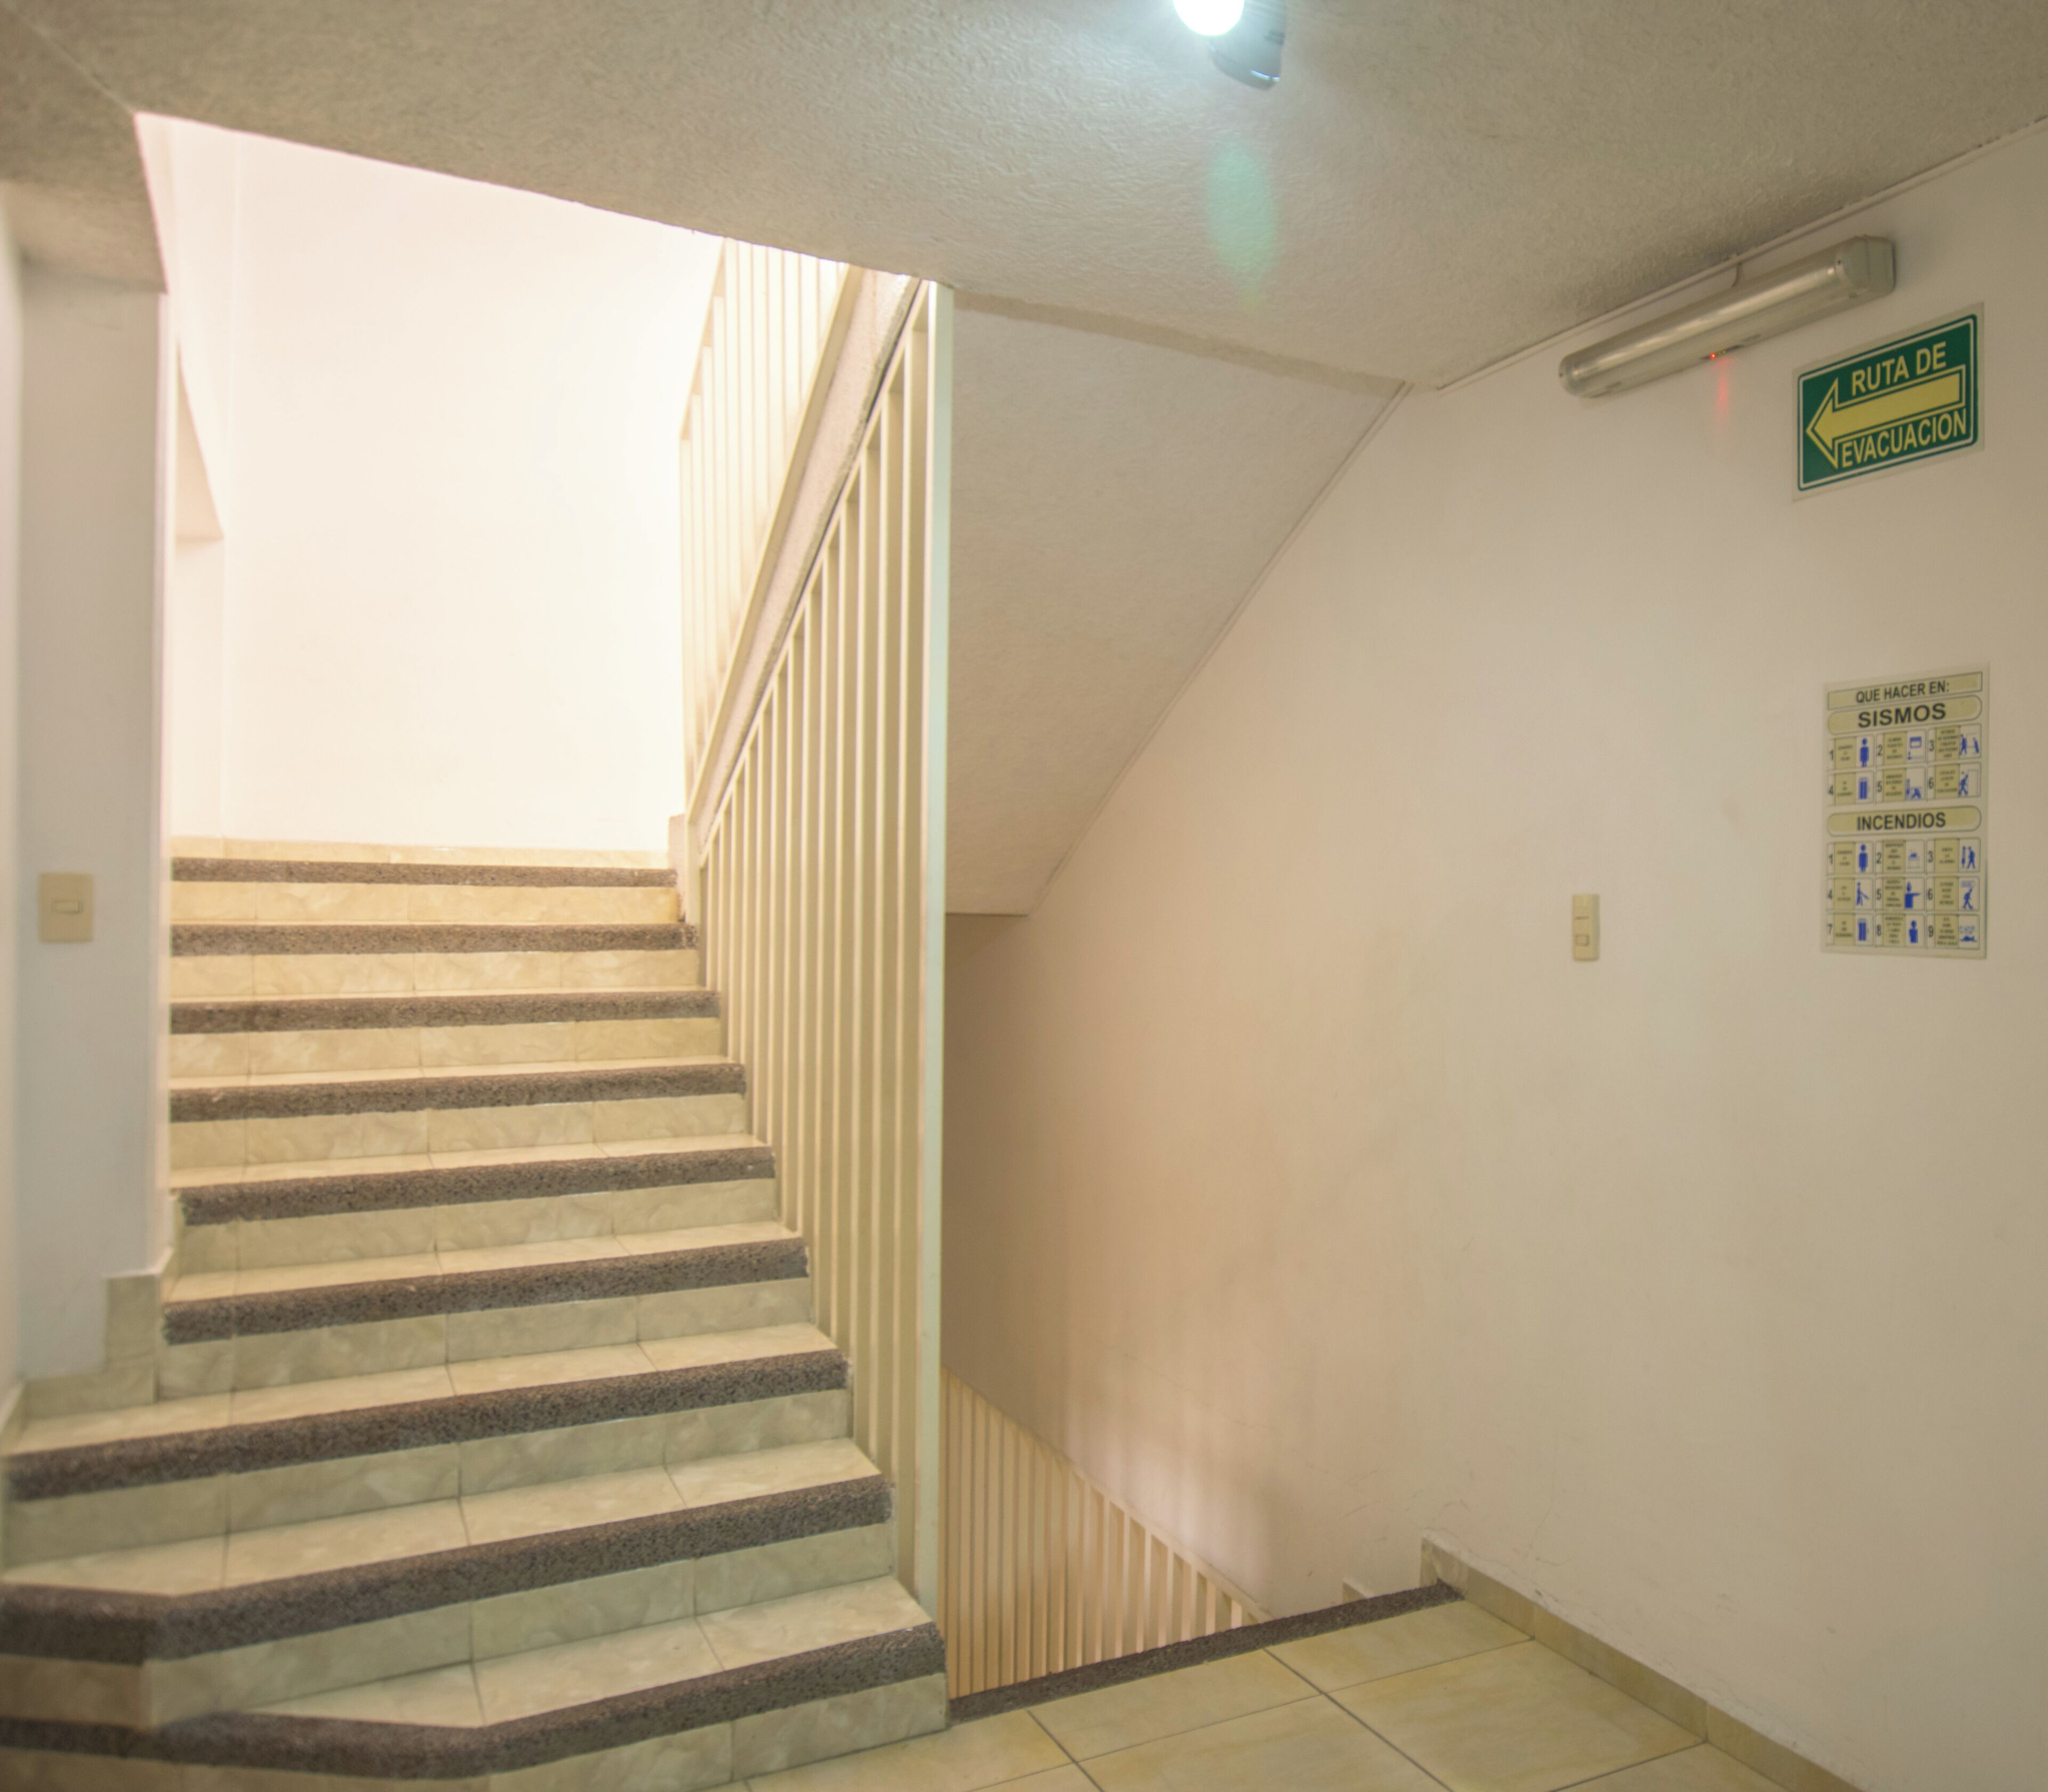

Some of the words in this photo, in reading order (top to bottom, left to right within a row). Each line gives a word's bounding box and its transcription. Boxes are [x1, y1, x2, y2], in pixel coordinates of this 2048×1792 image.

[1852, 355, 1909, 396] RUTA
[1916, 341, 1946, 375] DE
[1842, 408, 1966, 468] EVACUACION
[1856, 689, 1880, 703] QUE
[1884, 683, 1925, 700] HACER
[1930, 680, 1949, 694] EN:
[1858, 703, 1946, 729] SISMOS
[1877, 745, 1883, 756] 2
[1929, 740, 1934, 752] 3
[1829, 749, 1834, 761] 1
[1877, 781, 1882, 793] 5
[1929, 778, 1934, 789] 6
[1828, 786, 1834, 795] 4
[1857, 812, 1946, 831] INCENDIOS
[1829, 854, 1833, 865] 1
[1877, 852, 1882, 864] 2
[1928, 851, 1933, 863] 3
[1828, 889, 1833, 900] 4
[1877, 889, 1882, 900] 5
[1928, 888, 1933, 900] 6
[1827, 924, 1833, 936] 7
[1877, 924, 1882, 936] 8
[1929, 926, 1933, 938] 9
